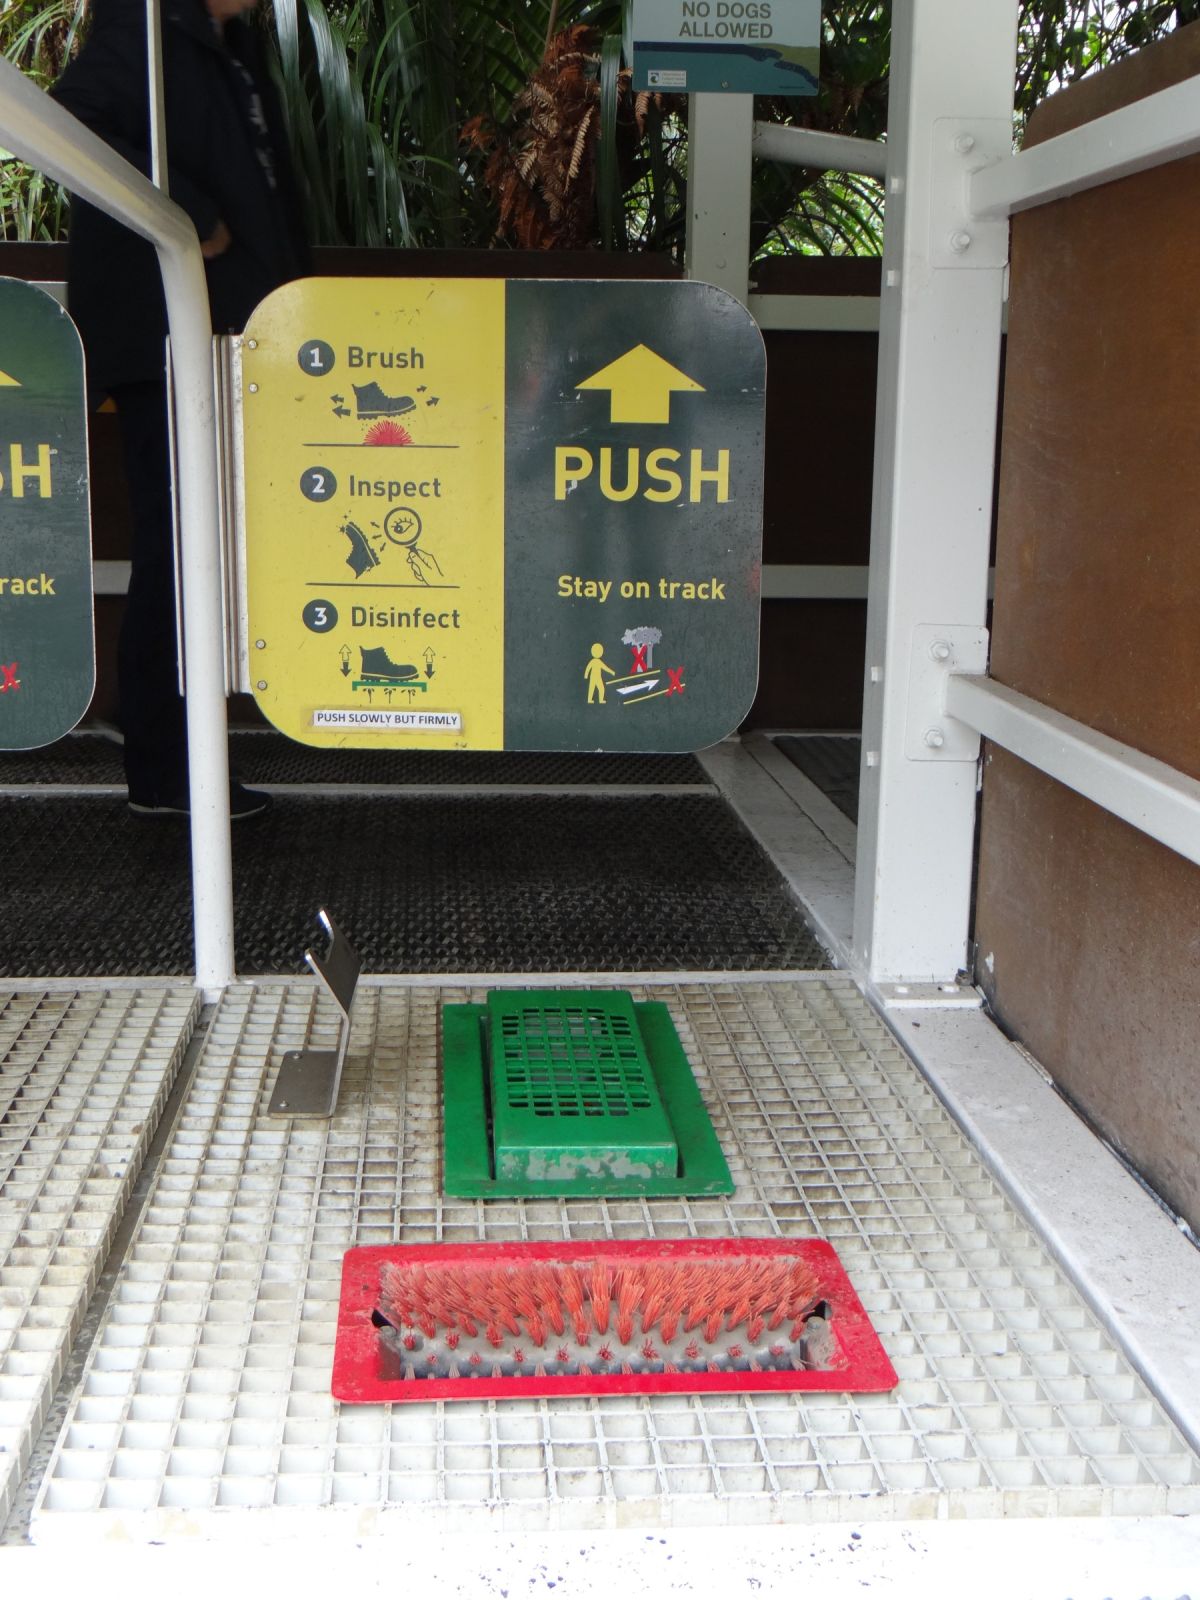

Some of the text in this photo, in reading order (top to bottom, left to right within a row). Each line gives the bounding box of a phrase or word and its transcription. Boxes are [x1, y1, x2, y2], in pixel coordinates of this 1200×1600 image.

[682, 2, 772, 19] NO DOGS
[678, 21, 773, 39] ALLOWED
[310, 346, 425, 369] 1 Brush
[0, 443, 52, 499] H
[554, 446, 730, 503] PUSH
[311, 474, 441, 502] 2 Inspect
[557, 575, 726, 602] Stay on track
[313, 606, 461, 629] 3 Disinfect
[317, 713, 458, 725] PUSH SLOWLY BUT FIRMLY
